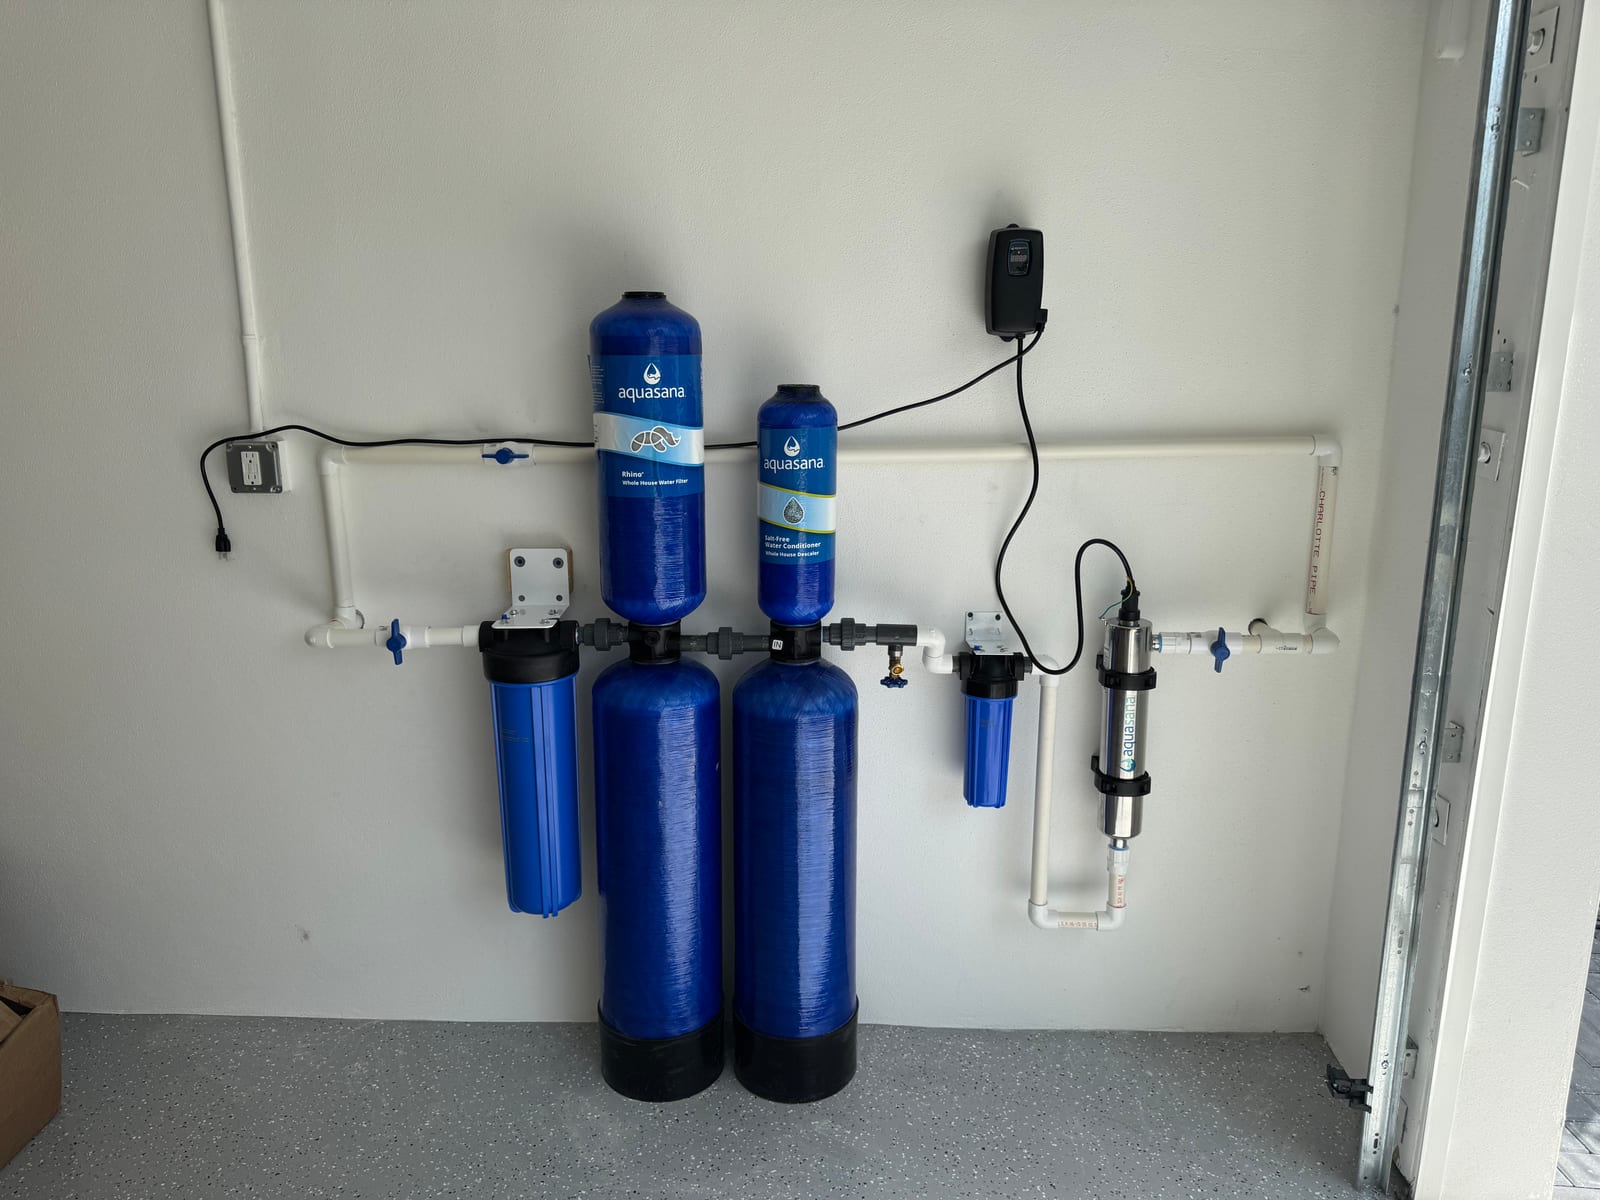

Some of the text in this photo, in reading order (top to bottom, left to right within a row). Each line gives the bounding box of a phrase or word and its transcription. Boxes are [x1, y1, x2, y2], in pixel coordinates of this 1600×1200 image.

[618, 386, 685, 403] aquasana
[763, 457, 824, 474] aquasana
[1313, 490, 1326, 558] CHARLOTTE
[765, 541, 782, 549] Water
[1310, 565, 1318, 595] PIPE
[773, 640, 782, 649] IN
[1122, 696, 1136, 757] aquasana
